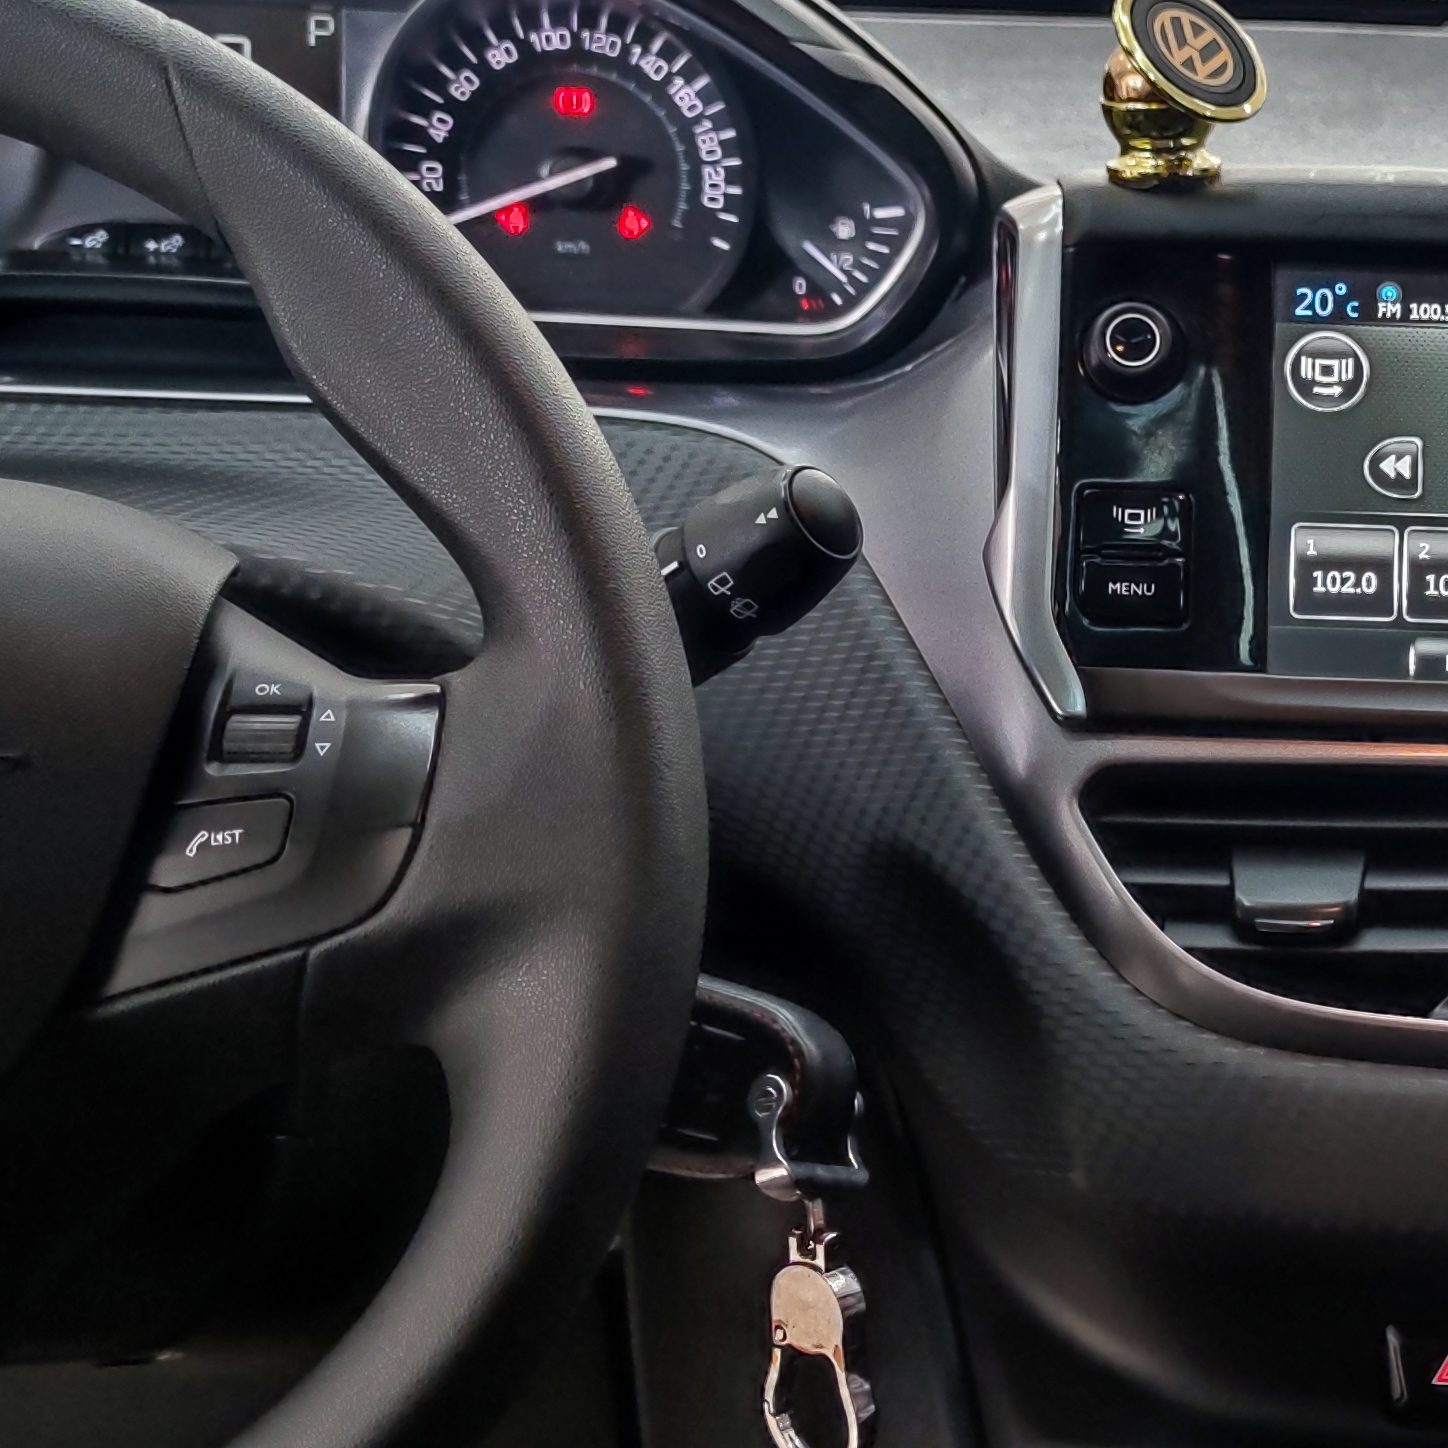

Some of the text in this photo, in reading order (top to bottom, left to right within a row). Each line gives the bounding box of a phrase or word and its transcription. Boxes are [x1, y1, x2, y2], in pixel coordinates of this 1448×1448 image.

[306, 12, 335, 47] P
[529, 27, 571, 52] 100
[580, 28, 622, 57] 120
[484, 39, 518, 70] 80
[628, 44, 669, 81] 140
[447, 69, 480, 101] 60
[665, 75, 703, 118] 160
[428, 110, 454, 143] 40
[692, 118, 723, 161] 180
[419, 160, 444, 192] 20
[701, 164, 726, 209] 200
[1378, 303, 1401, 319] FM
[1306, 539, 1318, 556] 1
[1418, 543, 1431, 560] 2
[1108, 581, 1156, 596] MENU
[1312, 570, 1378, 595] 102.0
[255, 683, 282, 696] OK
